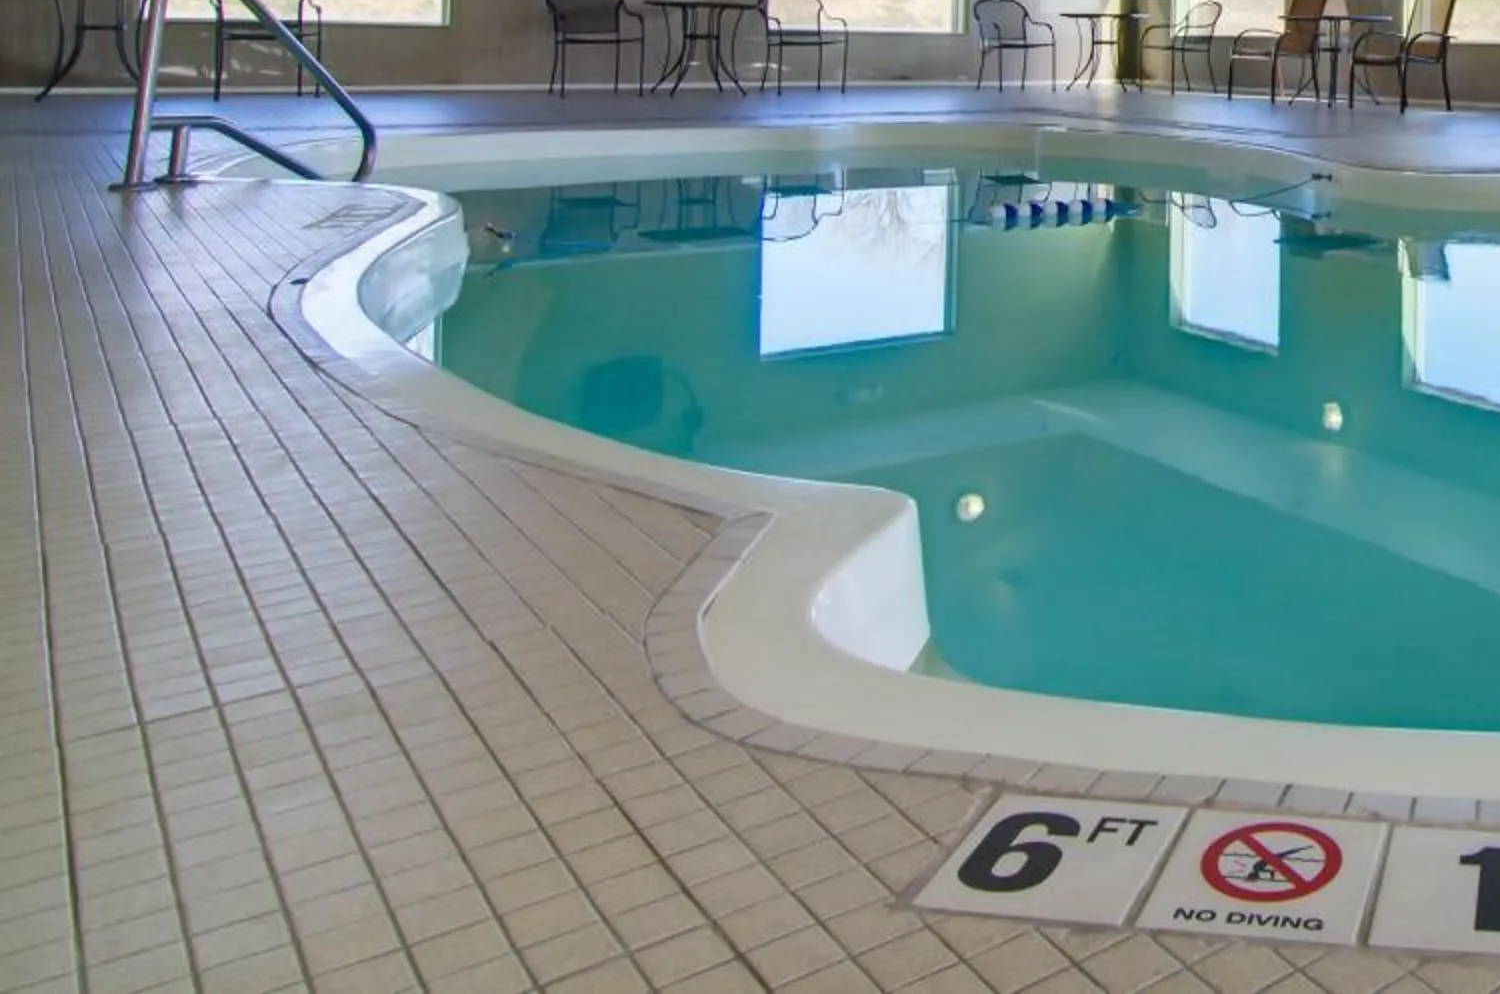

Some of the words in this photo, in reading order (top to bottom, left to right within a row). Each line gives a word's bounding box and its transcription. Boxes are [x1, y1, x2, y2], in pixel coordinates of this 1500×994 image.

[956, 811, 1082, 893] 6
[1086, 816, 1159, 847] FT
[1173, 907, 1218, 923] NO
[1225, 911, 1325, 932] DIVING
